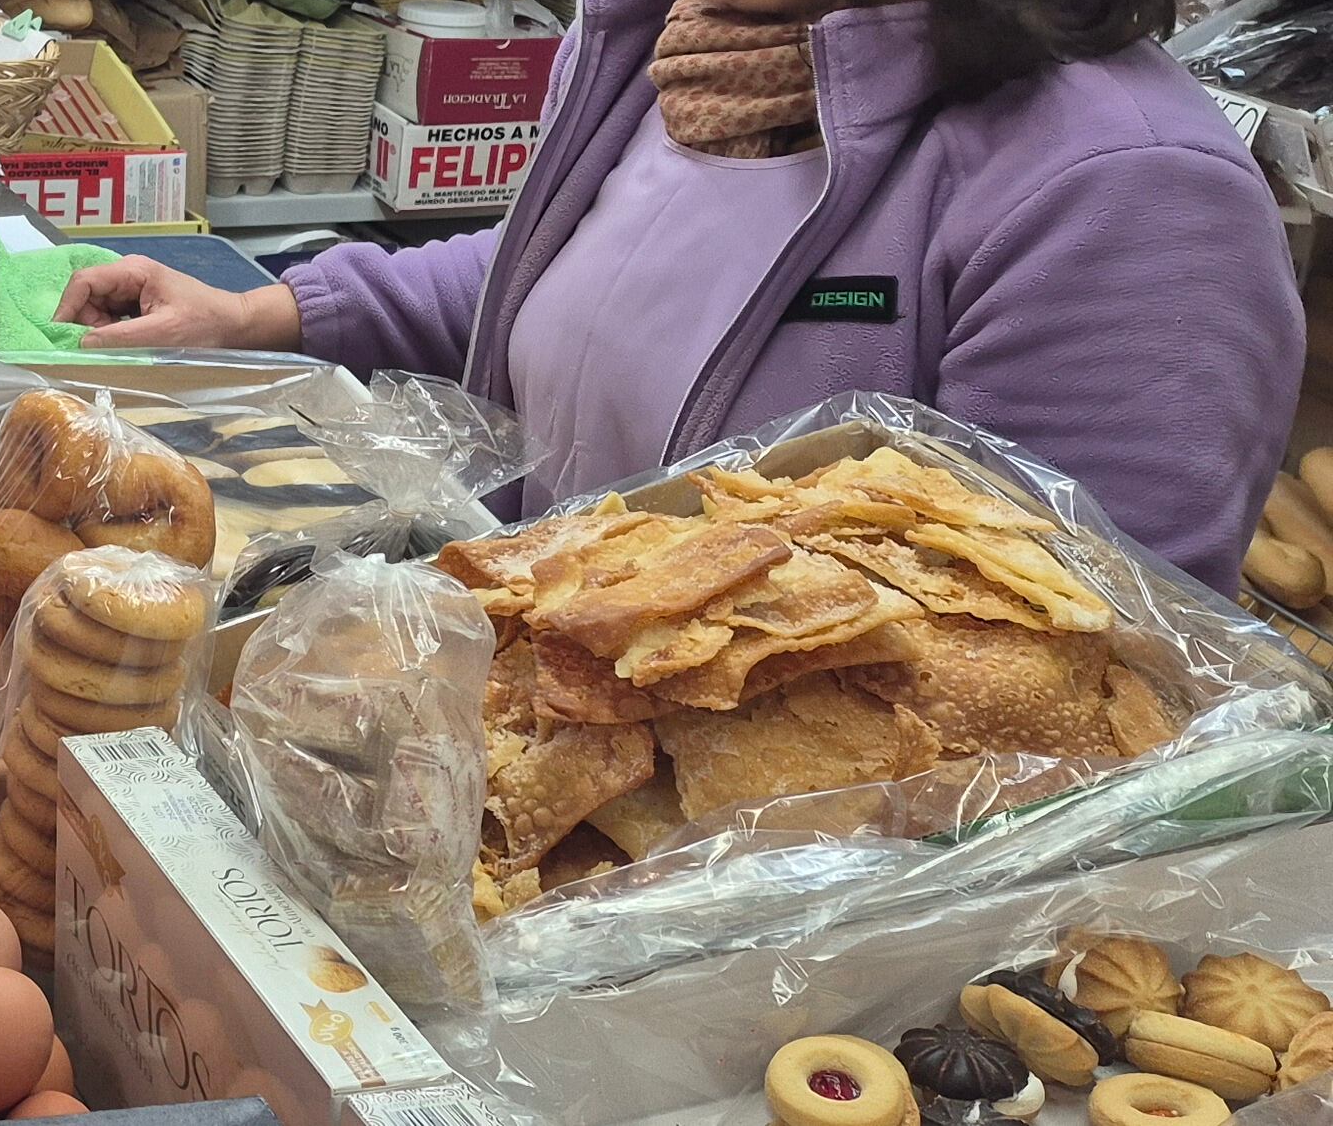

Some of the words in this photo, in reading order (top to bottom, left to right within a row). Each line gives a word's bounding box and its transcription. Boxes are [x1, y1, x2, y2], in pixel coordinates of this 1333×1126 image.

[428, 127, 505, 142] HECHOS
[511, 127, 523, 139] A
[66, 160, 109, 168] MUNDO
[408, 143, 536, 190] FELIP
[434, 189, 486, 198] MANTECADO
[447, 197, 475, 205] DESDE
[477, 195, 501, 203] HACE
[810, 291, 885, 307] DESIGN
